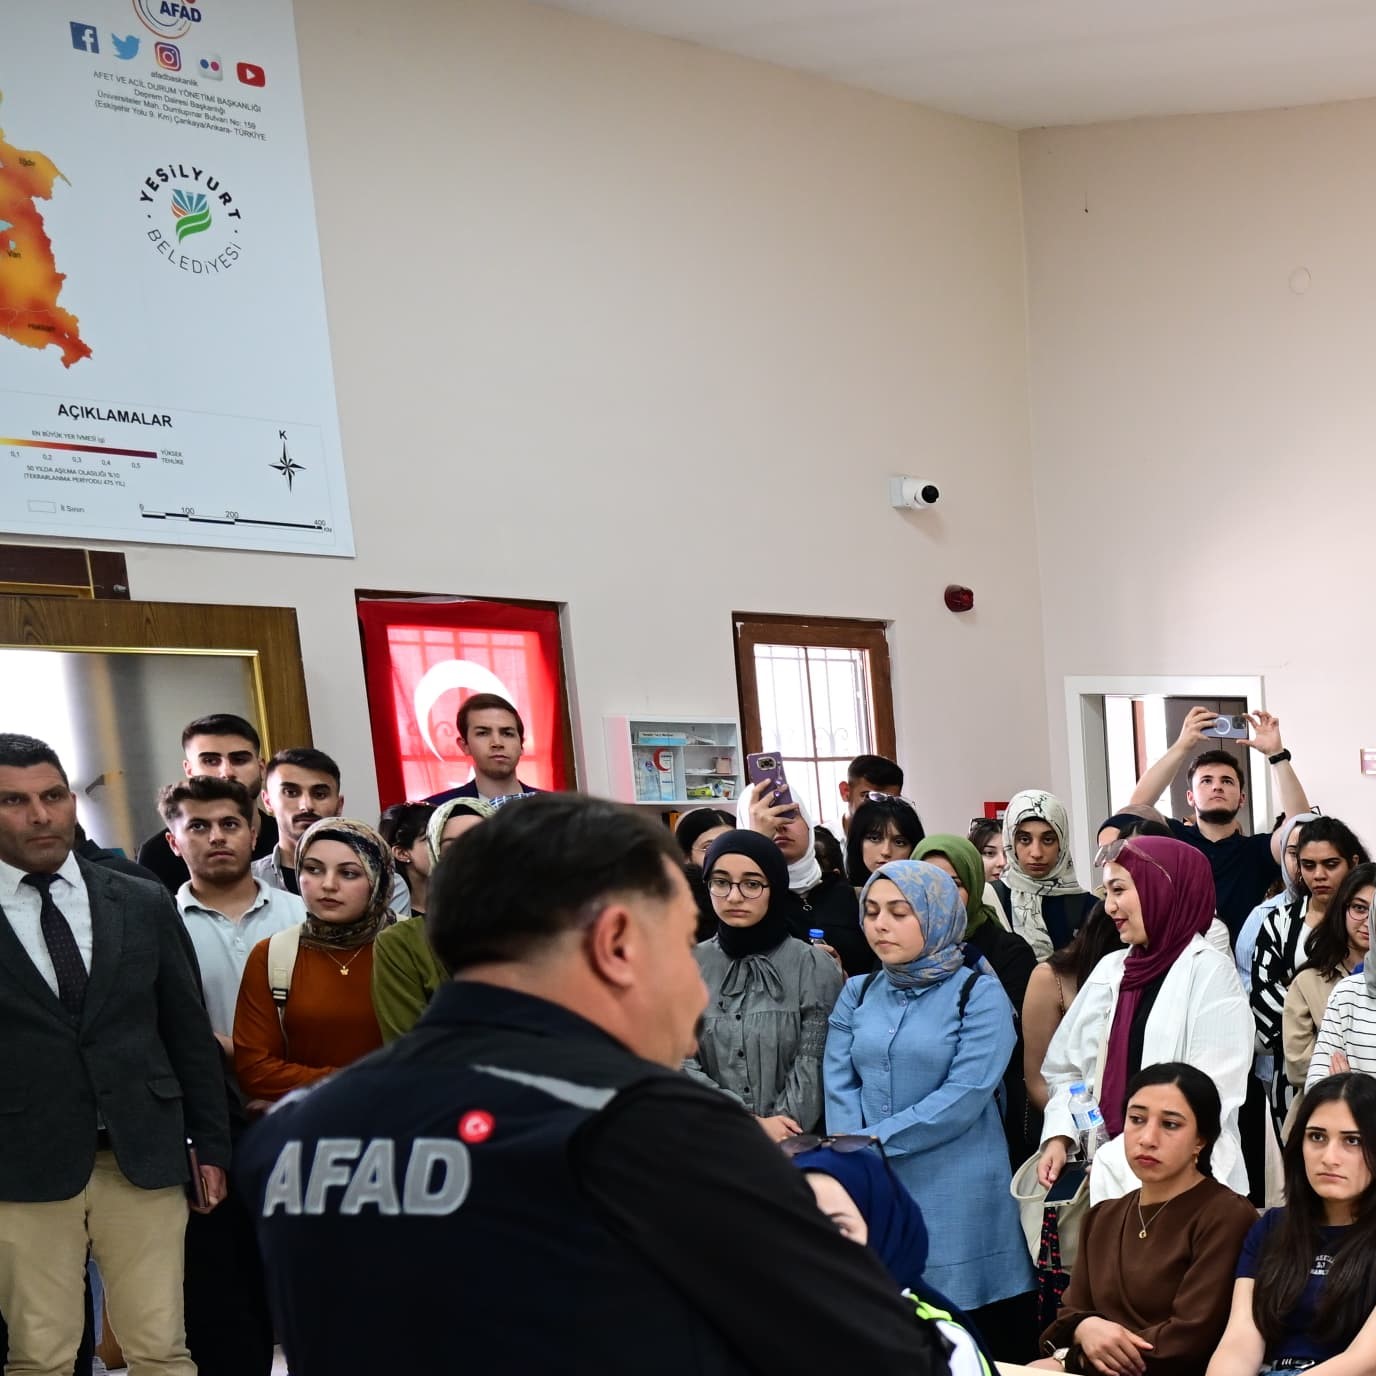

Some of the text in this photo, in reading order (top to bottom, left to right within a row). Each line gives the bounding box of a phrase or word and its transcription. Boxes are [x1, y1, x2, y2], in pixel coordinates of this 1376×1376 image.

[160, 1, 202, 22] AFAD
[93, 71, 113, 80] AFET
[116, 76, 127, 84] VE
[148, 82, 177, 94] DURUM
[134, 90, 163, 101] Deprem
[147, 230, 242, 274] BELEDİYESİ
[58, 403, 173, 428] AÇIKLAMALAR
[278, 430, 287, 440] K
[226, 510, 239, 519] 200
[262, 1137, 472, 1217] AFAD
